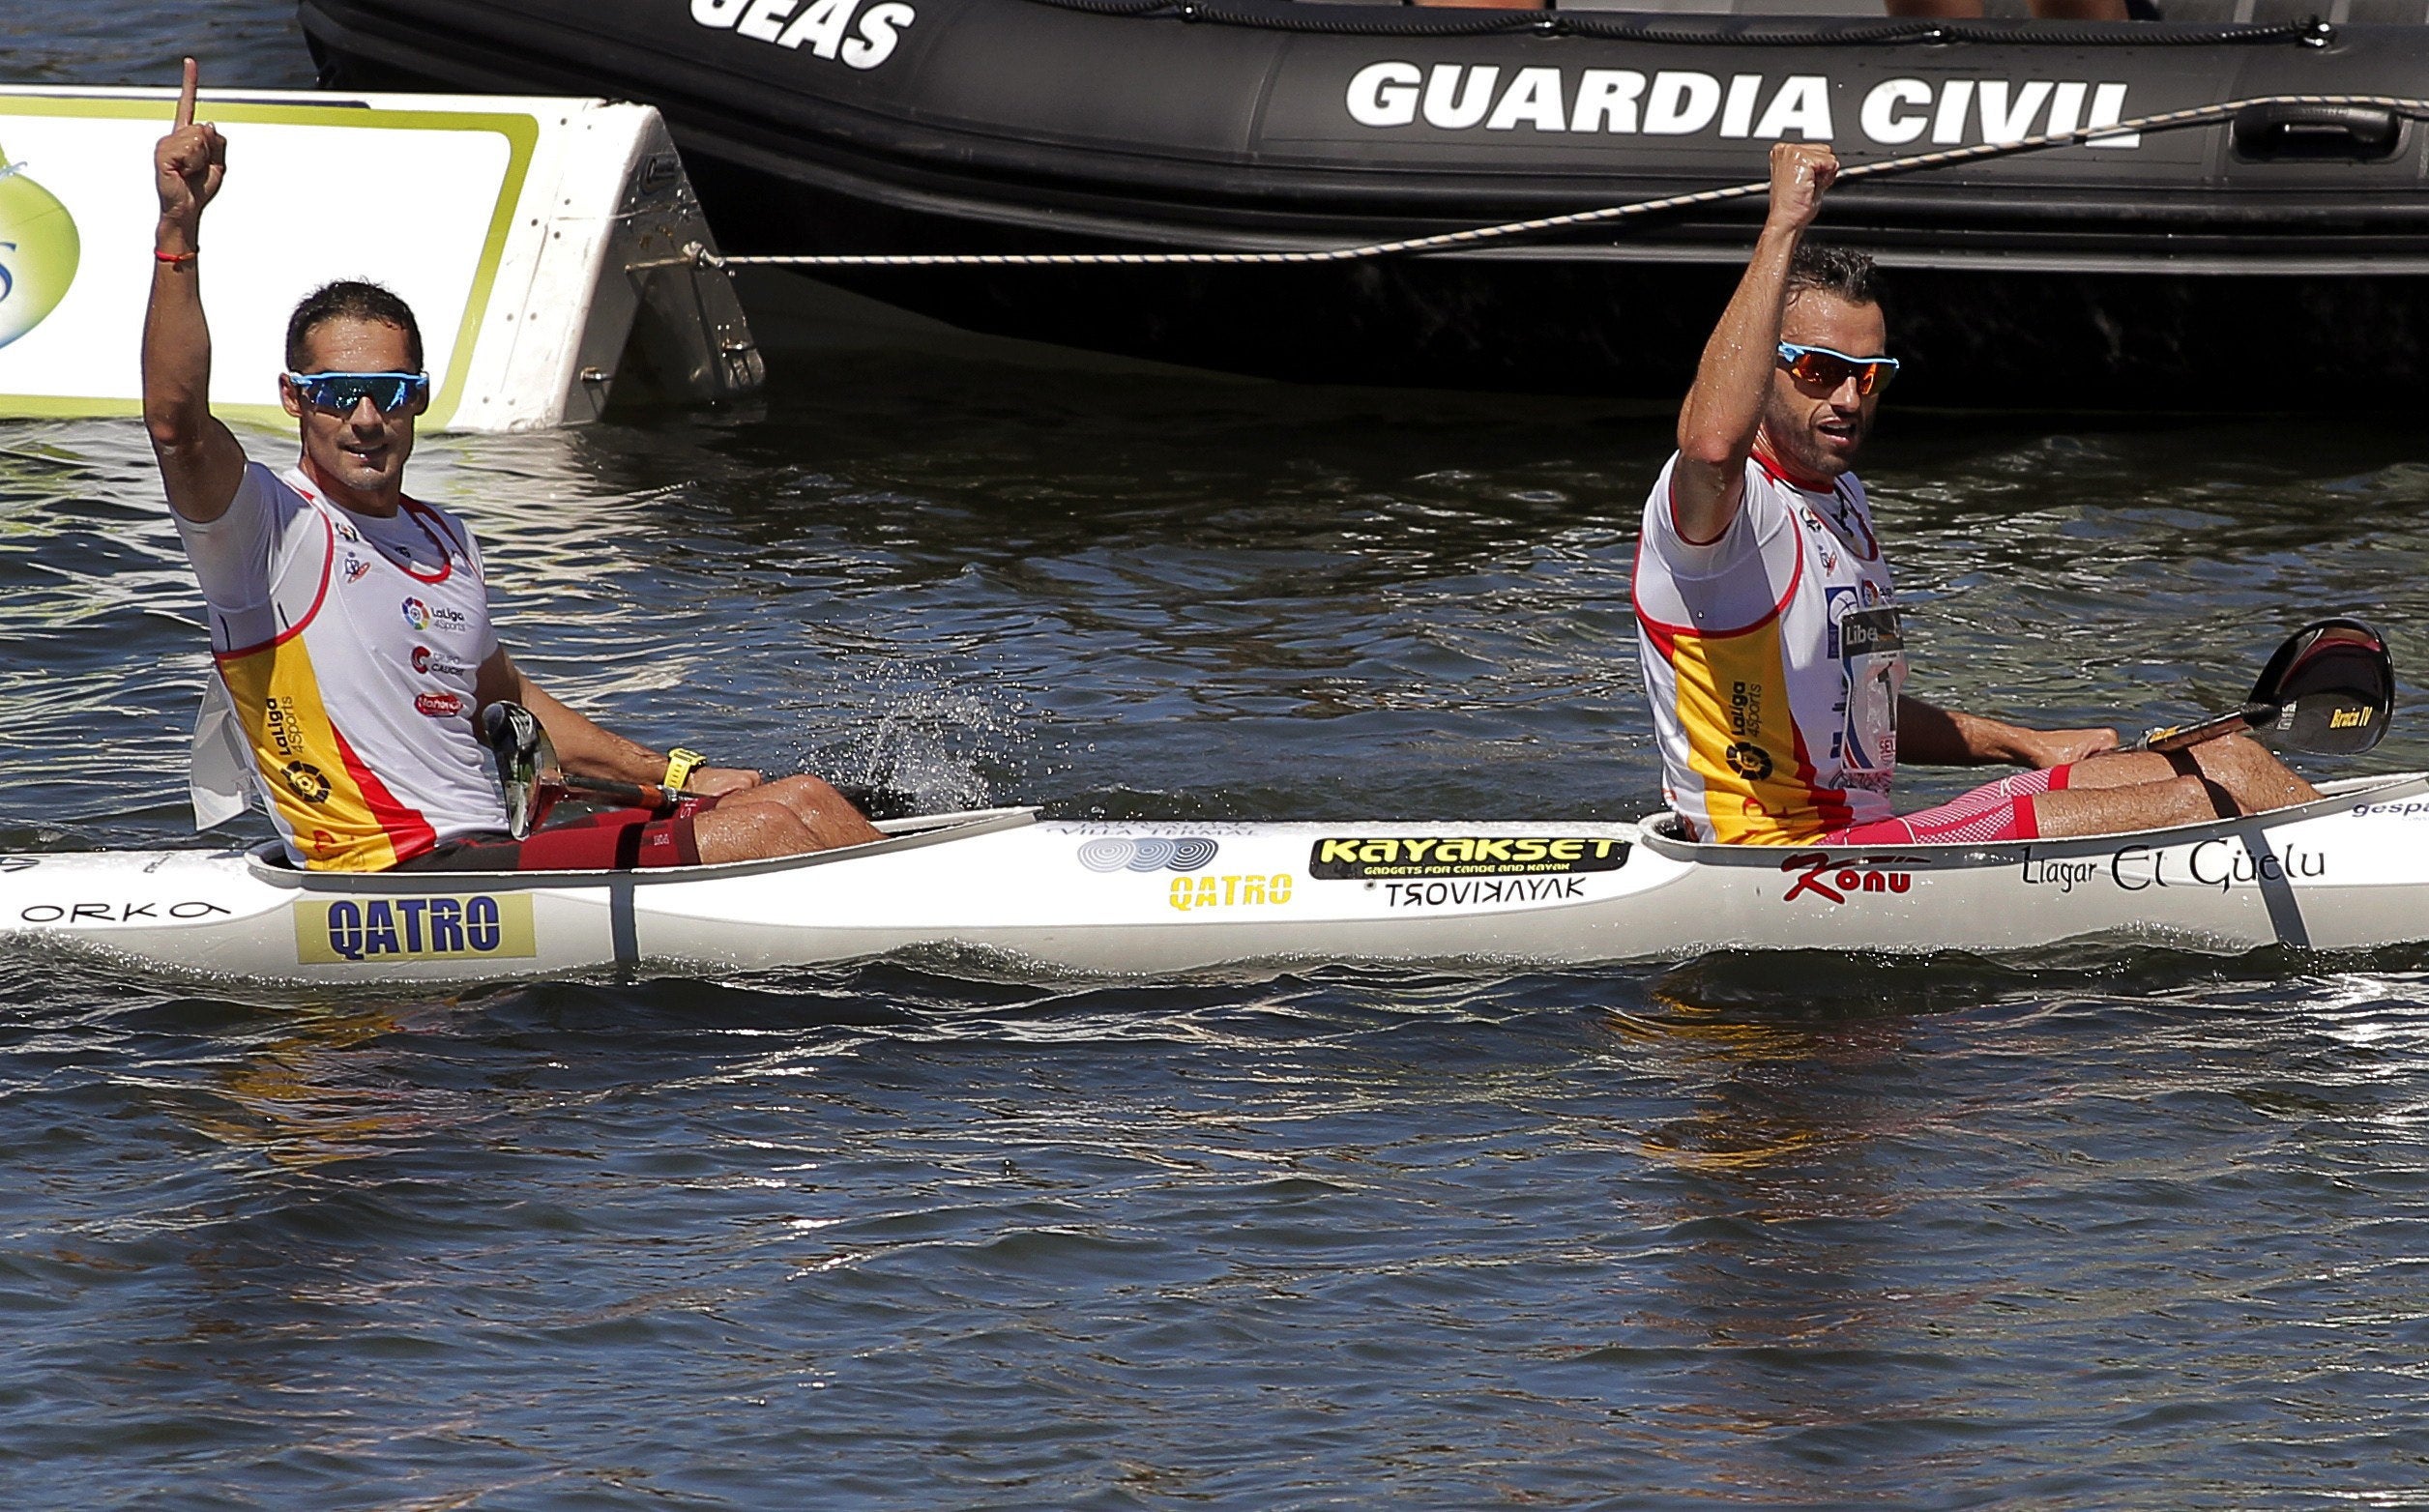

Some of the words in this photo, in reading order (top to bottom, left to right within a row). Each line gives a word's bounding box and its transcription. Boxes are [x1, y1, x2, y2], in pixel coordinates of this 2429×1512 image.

[1345, 61, 1835, 140] GUARDIA
[1860, 77, 2141, 148] CIVIL
[266, 697, 293, 756] LaLiga
[1729, 681, 1748, 736] LaLiga
[1169, 873, 1293, 911] QATRO
[1363, 865, 1422, 875] GADGETS
[1424, 865, 1450, 875] FOR
[1452, 864, 1496, 874] CANOE
[1527, 862, 1570, 872] KAYAK
[2022, 845, 2097, 894] Llagar
[2111, 844, 2170, 890] El
[2189, 839, 2325, 895] Güelu
[328, 895, 501, 961] QATRO
